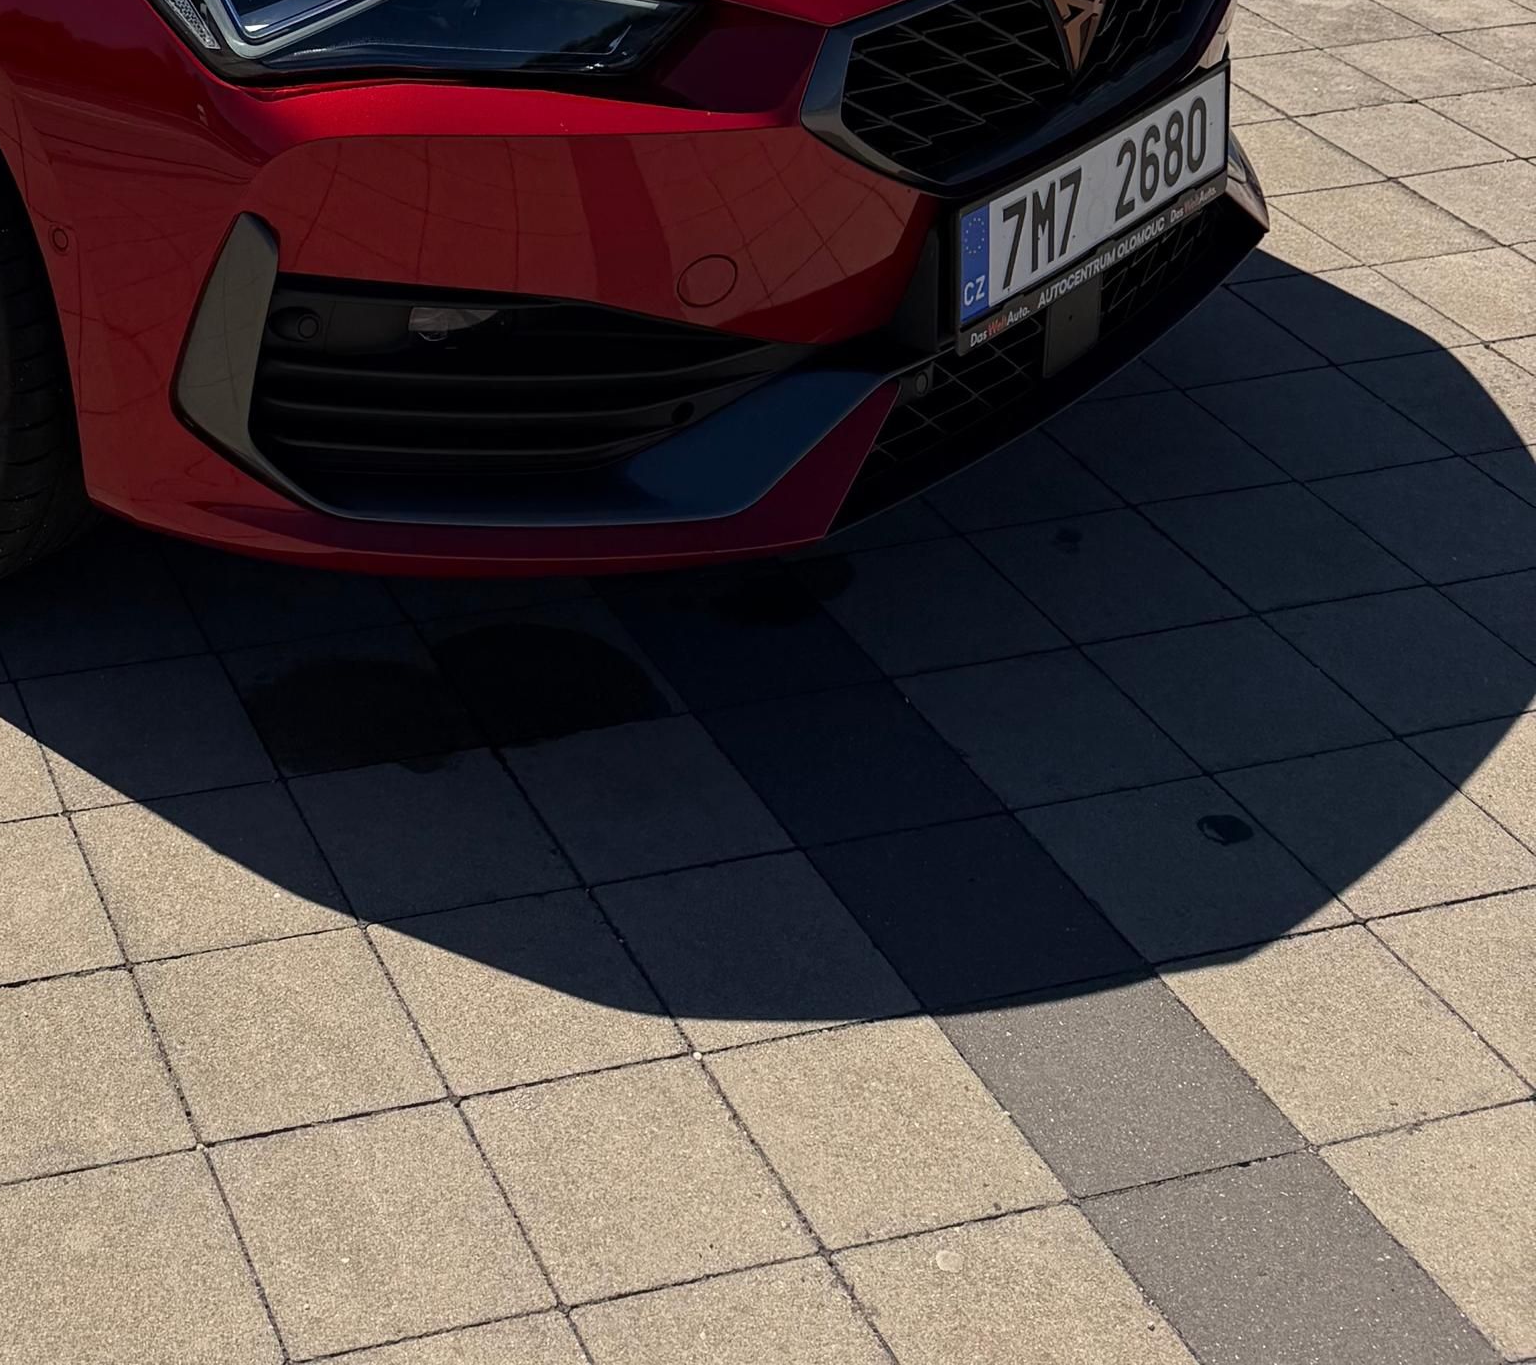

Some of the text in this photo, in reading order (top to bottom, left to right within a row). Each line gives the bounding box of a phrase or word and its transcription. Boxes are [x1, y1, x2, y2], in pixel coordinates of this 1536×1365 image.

[1002, 96, 1207, 291] 7M7 2680
[964, 274, 986, 307] CZ
[1037, 216, 1165, 309] AUTOCENTRUM OLOMOUC
